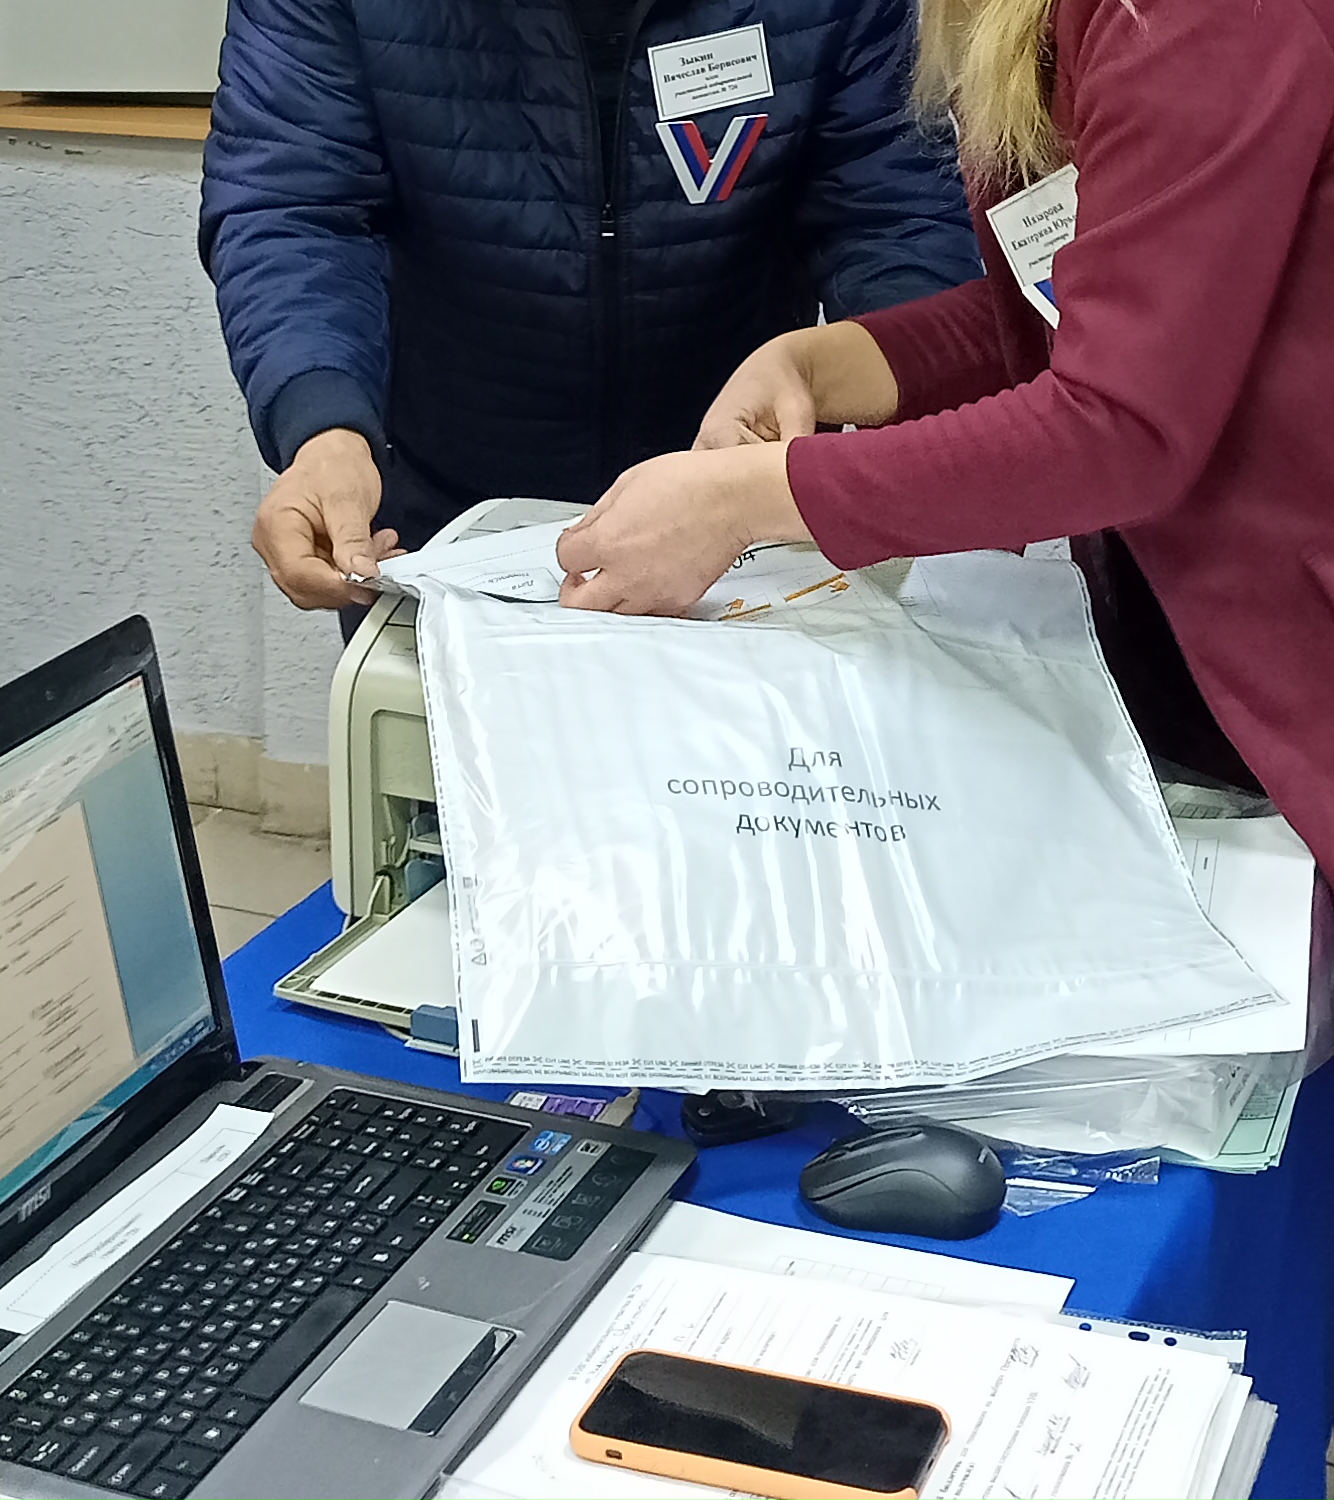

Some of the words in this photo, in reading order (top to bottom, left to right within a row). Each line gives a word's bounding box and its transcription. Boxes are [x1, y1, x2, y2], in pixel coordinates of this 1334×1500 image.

[788, 747, 843, 773] Для
[667, 778, 941, 811] сопроводительных
[736, 813, 907, 842] документов
